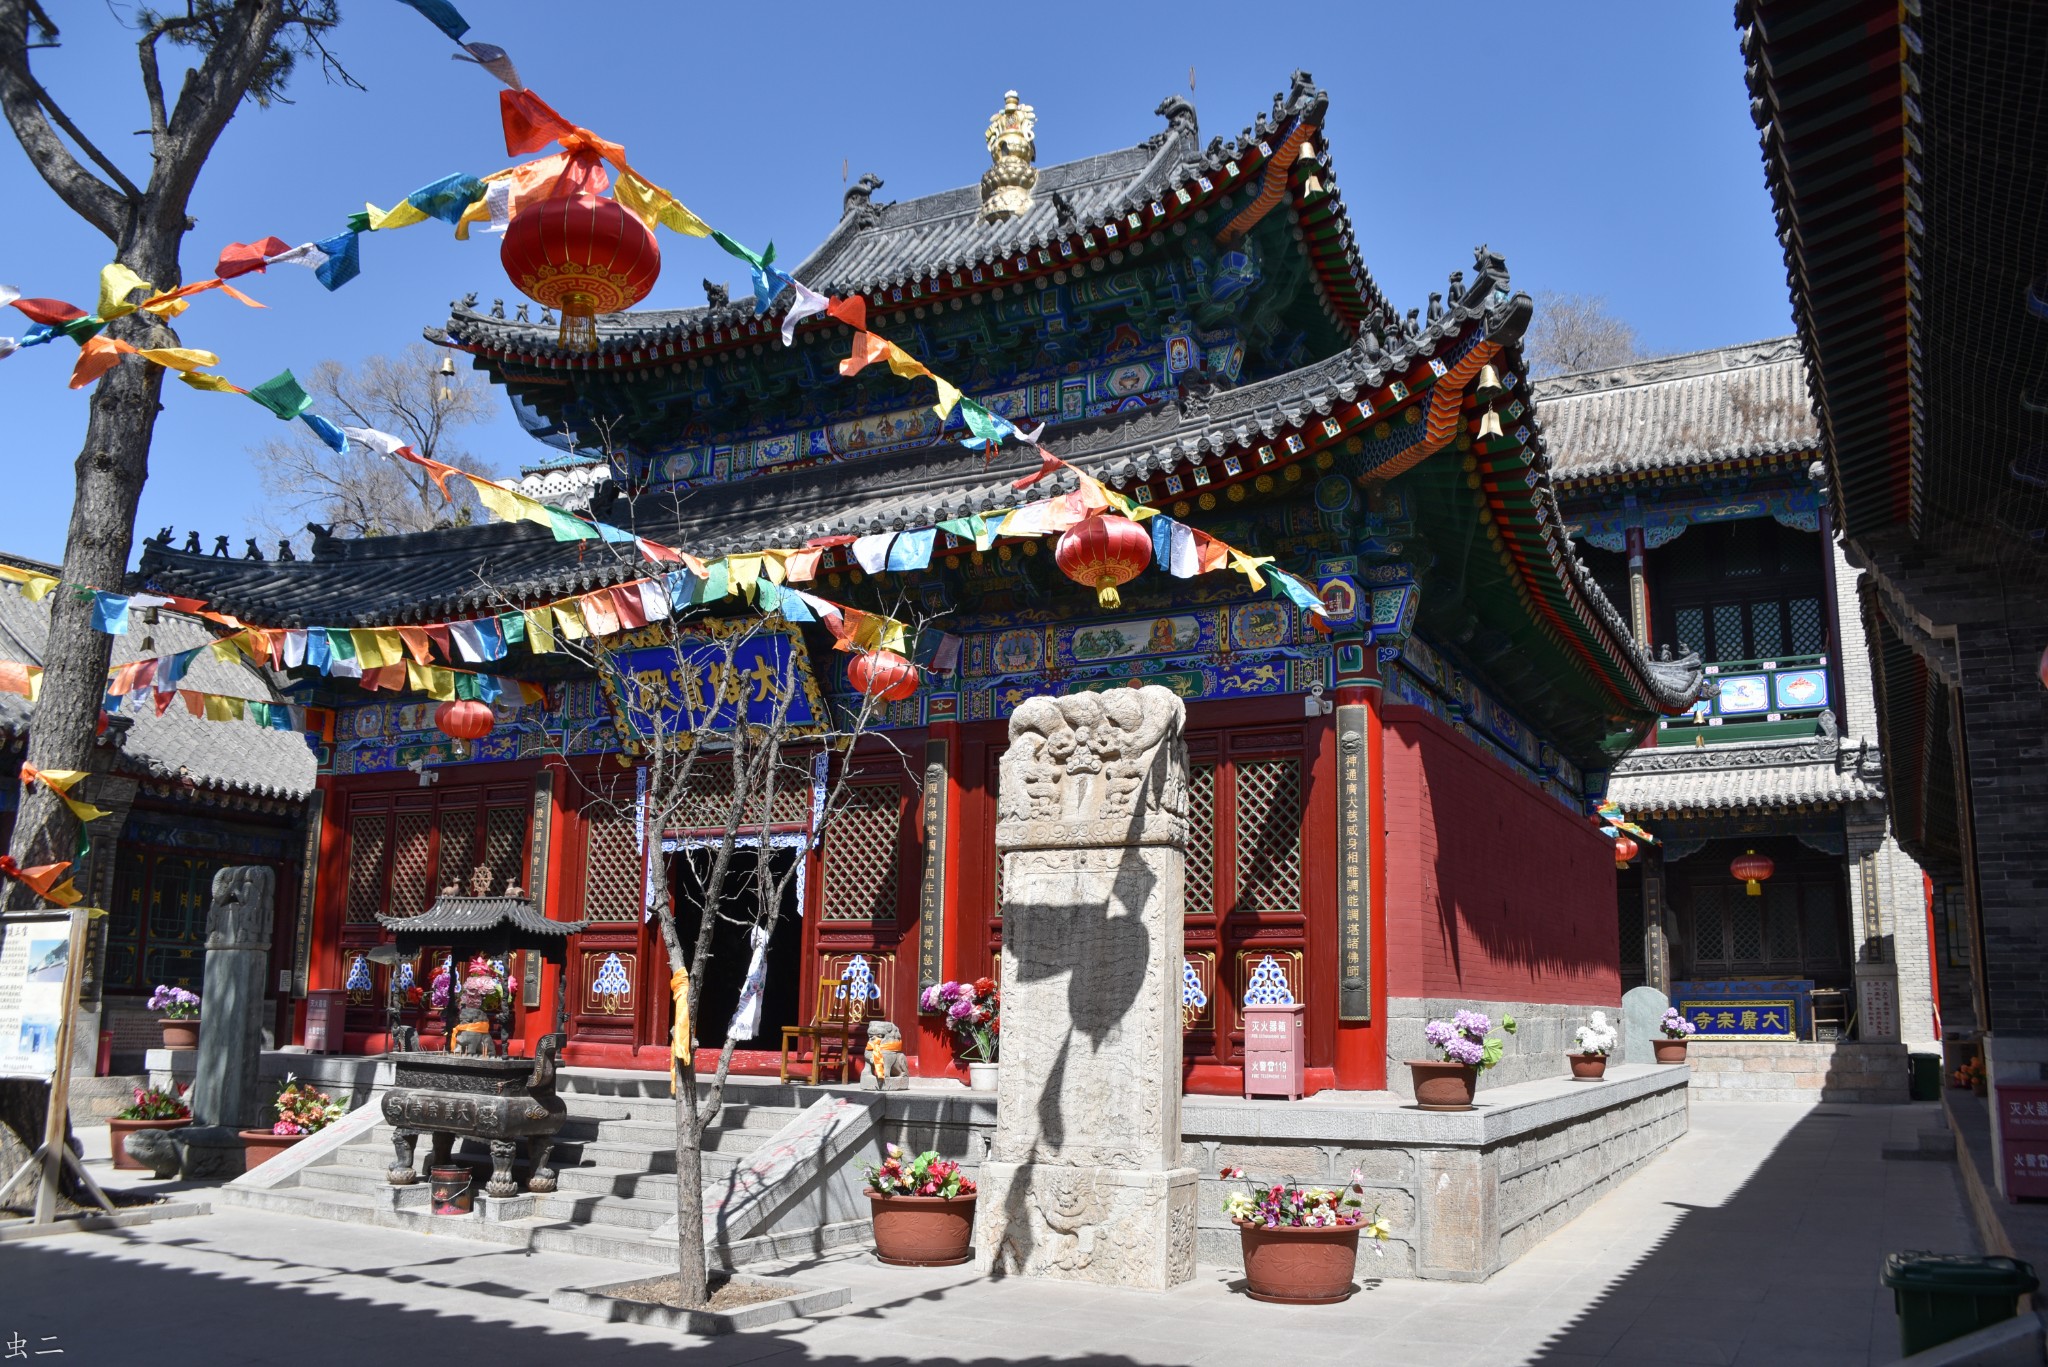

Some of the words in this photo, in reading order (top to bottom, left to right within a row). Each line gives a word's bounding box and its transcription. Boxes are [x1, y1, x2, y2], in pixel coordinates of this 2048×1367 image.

[635, 655, 786, 713] 大雄寶殿
[1251, 1020, 1287, 1032] 灭火器箱
[1693, 1010, 1784, 1031] 大廣宗寺
